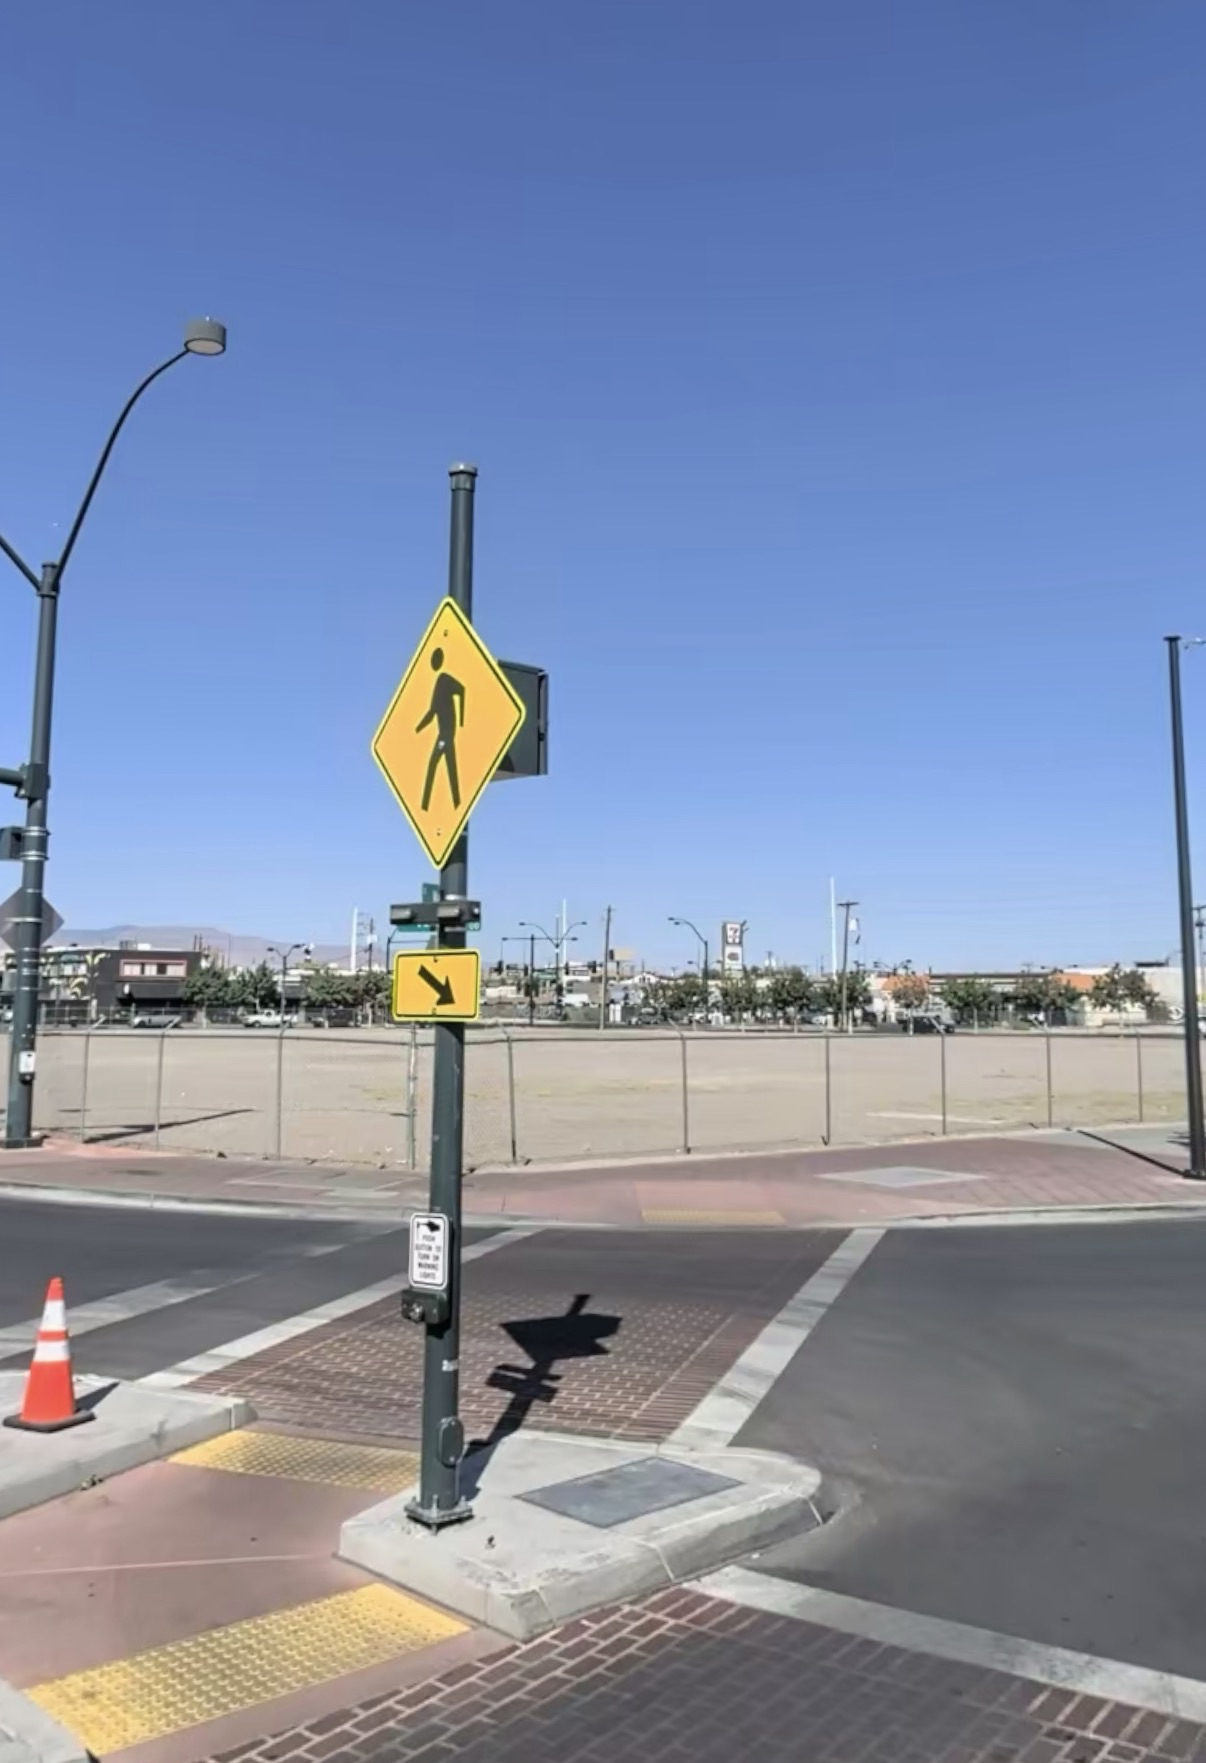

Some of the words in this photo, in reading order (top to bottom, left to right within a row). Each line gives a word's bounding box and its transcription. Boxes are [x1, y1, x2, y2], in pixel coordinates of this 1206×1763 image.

[422, 1234, 436, 1242] PUSH
[415, 1243, 432, 1251] BUTTON
[418, 1262, 439, 1271] WARNING
[419, 1271, 436, 1280] LIGHTS
